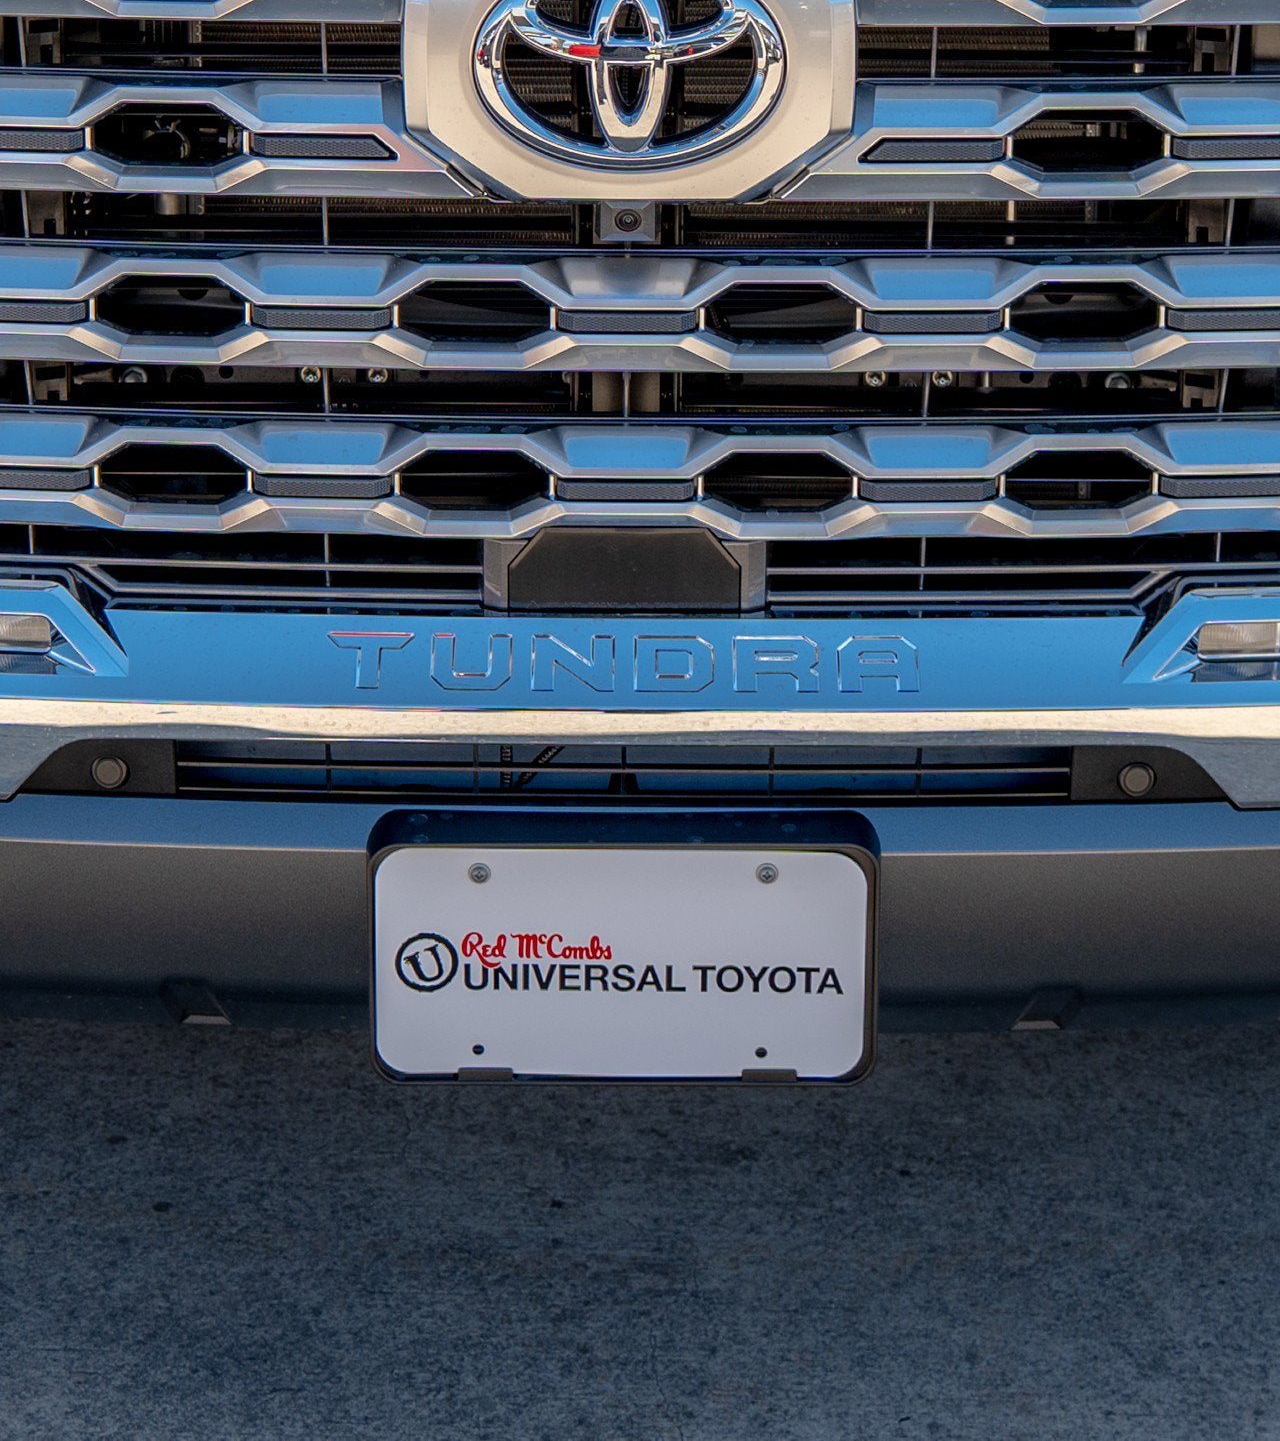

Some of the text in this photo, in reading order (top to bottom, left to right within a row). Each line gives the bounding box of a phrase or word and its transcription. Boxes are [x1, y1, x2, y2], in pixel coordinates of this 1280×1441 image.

[326, 631, 920, 694] TUNDRA
[461, 931, 613, 968] Red McCombs
[463, 962, 845, 995] UNIVERSAL TOYOTA
